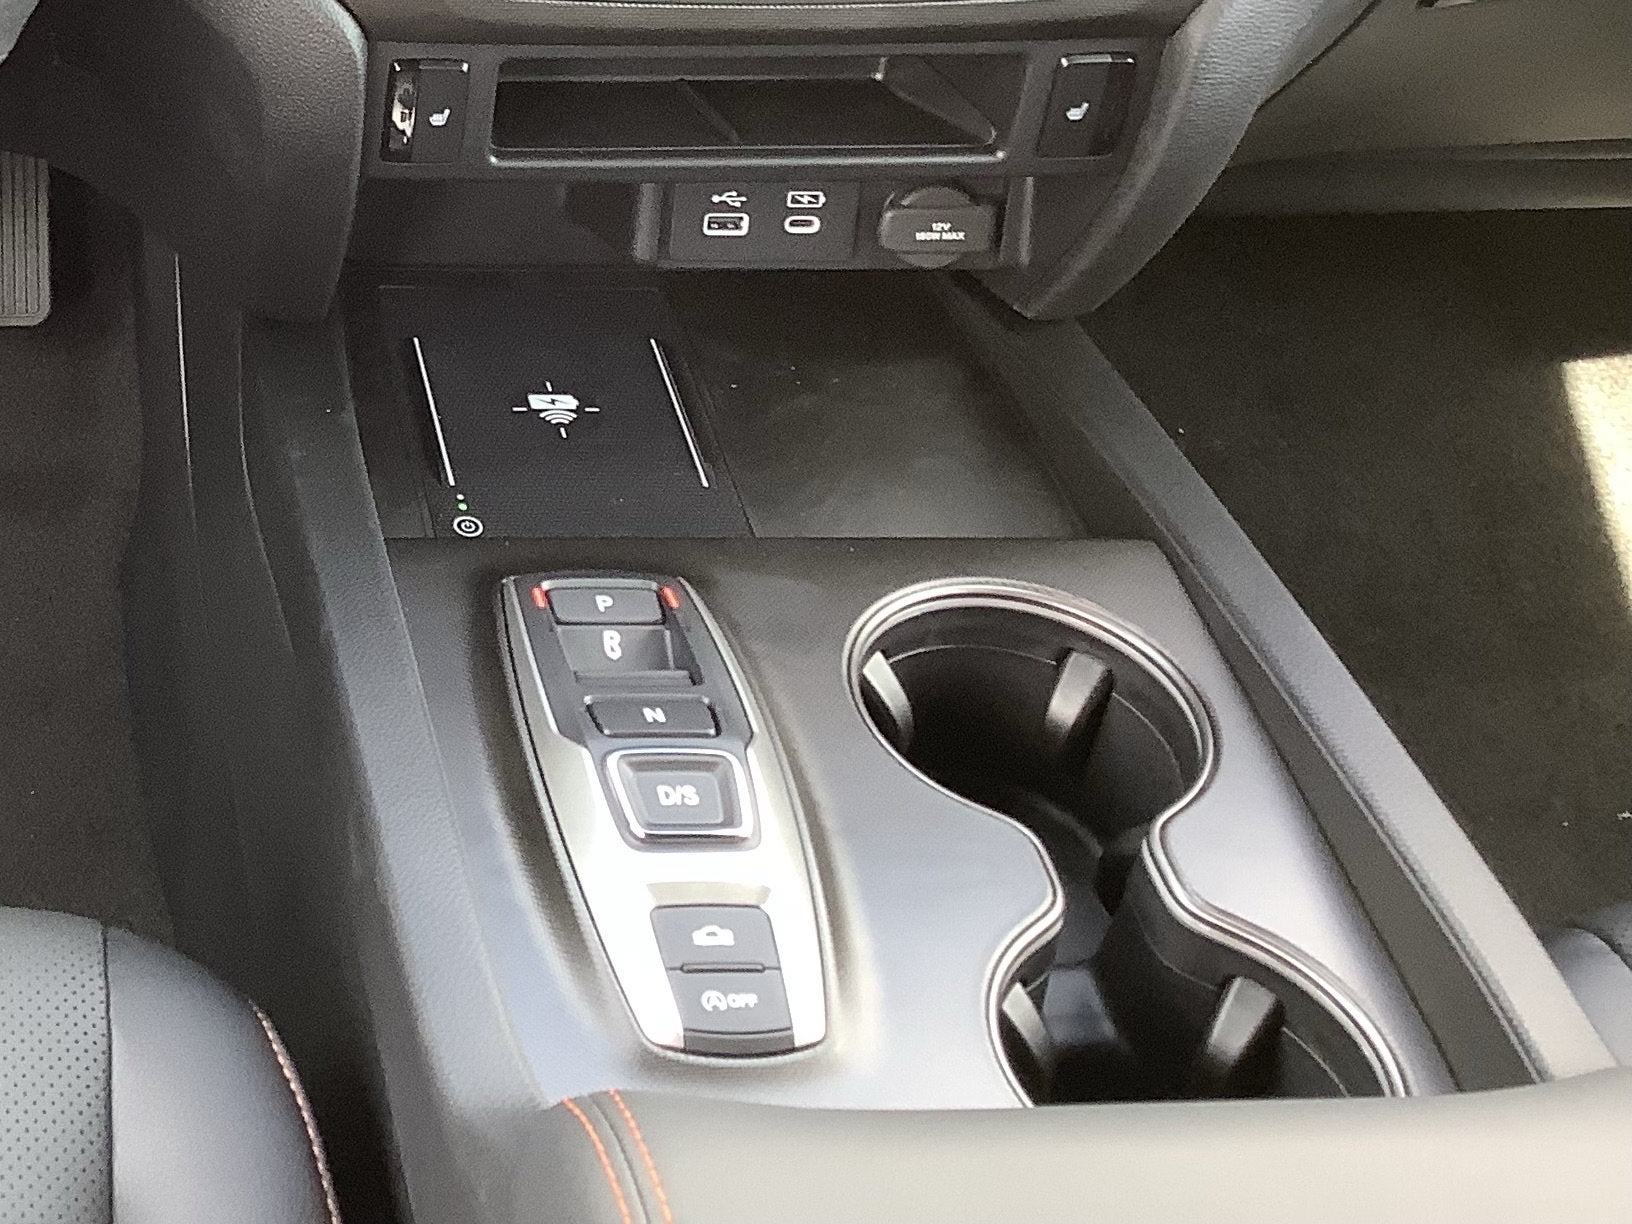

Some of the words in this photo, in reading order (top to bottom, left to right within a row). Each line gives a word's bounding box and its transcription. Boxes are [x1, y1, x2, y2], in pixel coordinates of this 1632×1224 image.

[941, 231, 966, 241] MAX
[594, 594, 614, 613] P
[641, 706, 667, 724] N
[656, 784, 700, 806] D/S
[726, 992, 759, 1009] OFF
